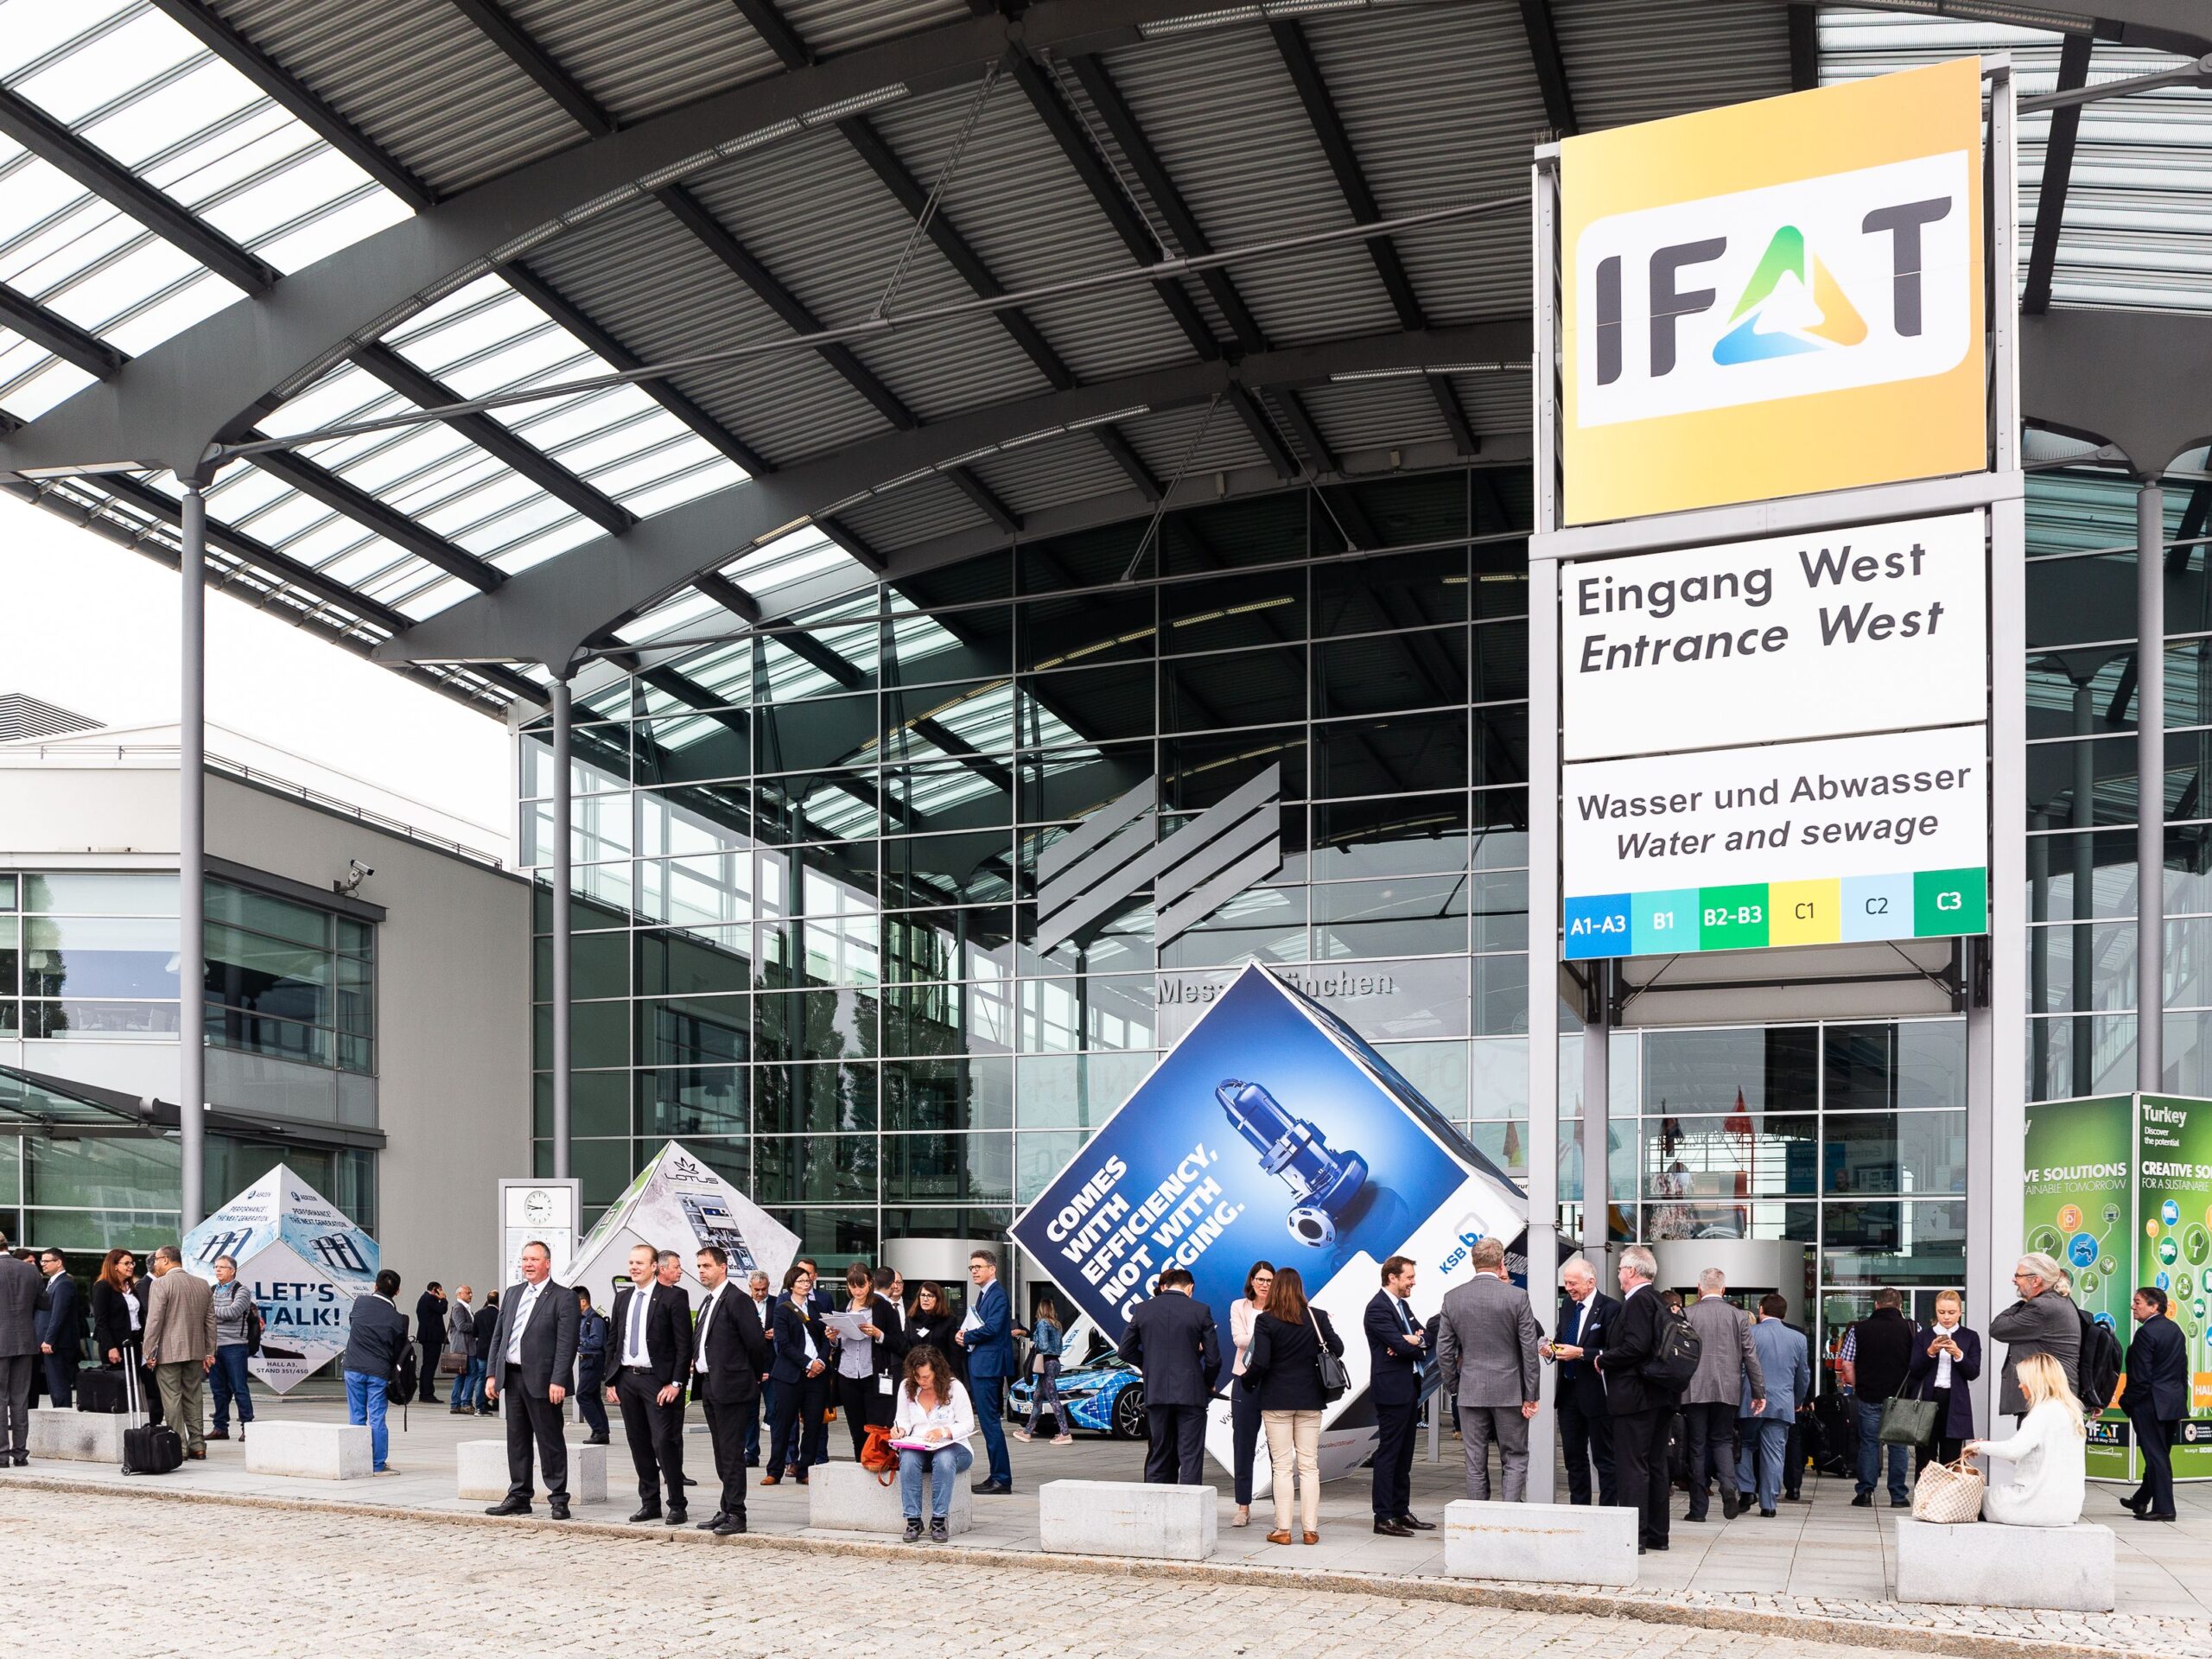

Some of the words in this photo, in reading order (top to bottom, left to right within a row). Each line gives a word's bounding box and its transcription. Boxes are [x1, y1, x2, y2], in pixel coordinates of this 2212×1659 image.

[1596, 196, 1952, 385] IFAT
[1578, 566, 1772, 619] Eingang
[1798, 543, 1926, 588] West
[1580, 625, 1789, 673] Entrance
[1819, 601, 1944, 645] West
[1578, 789, 1702, 821] Wasser
[1714, 779, 1779, 809] und
[1789, 767, 1971, 804] Abwasser
[1617, 828, 1714, 860] Water
[1725, 821, 1790, 851] and
[1801, 815, 1939, 845] sewage
[1795, 901, 1815, 920] C1
[1865, 897, 1889, 915] C2
[1936, 892, 1962, 912] C3
[1570, 914, 1626, 936] A1-A3
[1652, 911, 1675, 931] B1
[1703, 906, 1763, 926] B2-B3
[1156, 976, 1225, 1004] Mess
[1281, 968, 1394, 997] ünchen
[2143, 1105, 2187, 1128] Turkey
[2144, 1127, 2170, 1137] Discover
[2144, 1136, 2154, 1145] the
[2154, 1138, 2180, 1147] potential
[664, 1173, 719, 1185] LOTUS
[2044, 1162, 2127, 1182] SOLUTIONS
[2142, 1160, 2193, 1178] CREATIVE
[2195, 1164, 2212, 1179] SO
[2024, 1183, 2063, 1195] AINABLE
[2064, 1179, 2126, 1192] TOMORROW
[2142, 1178, 2157, 1189] FOR
[2157, 1179, 2164, 1189] A
[2164, 1179, 2209, 1192] SUSTAINABLE
[1046, 1154, 1128, 1243] COMES
[1080, 1142, 1218, 1286] EFFICIENCY,
[1061, 1192, 1130, 1264] WITH
[1099, 1244, 1154, 1306] NOT
[1151, 1175, 1223, 1249] WITH
[1439, 1247, 1467, 1274] KSB
[255, 1281, 334, 1302] LET'S
[259, 1306, 340, 1326] TALK!
[2088, 1423, 2120, 1439] IFAT
